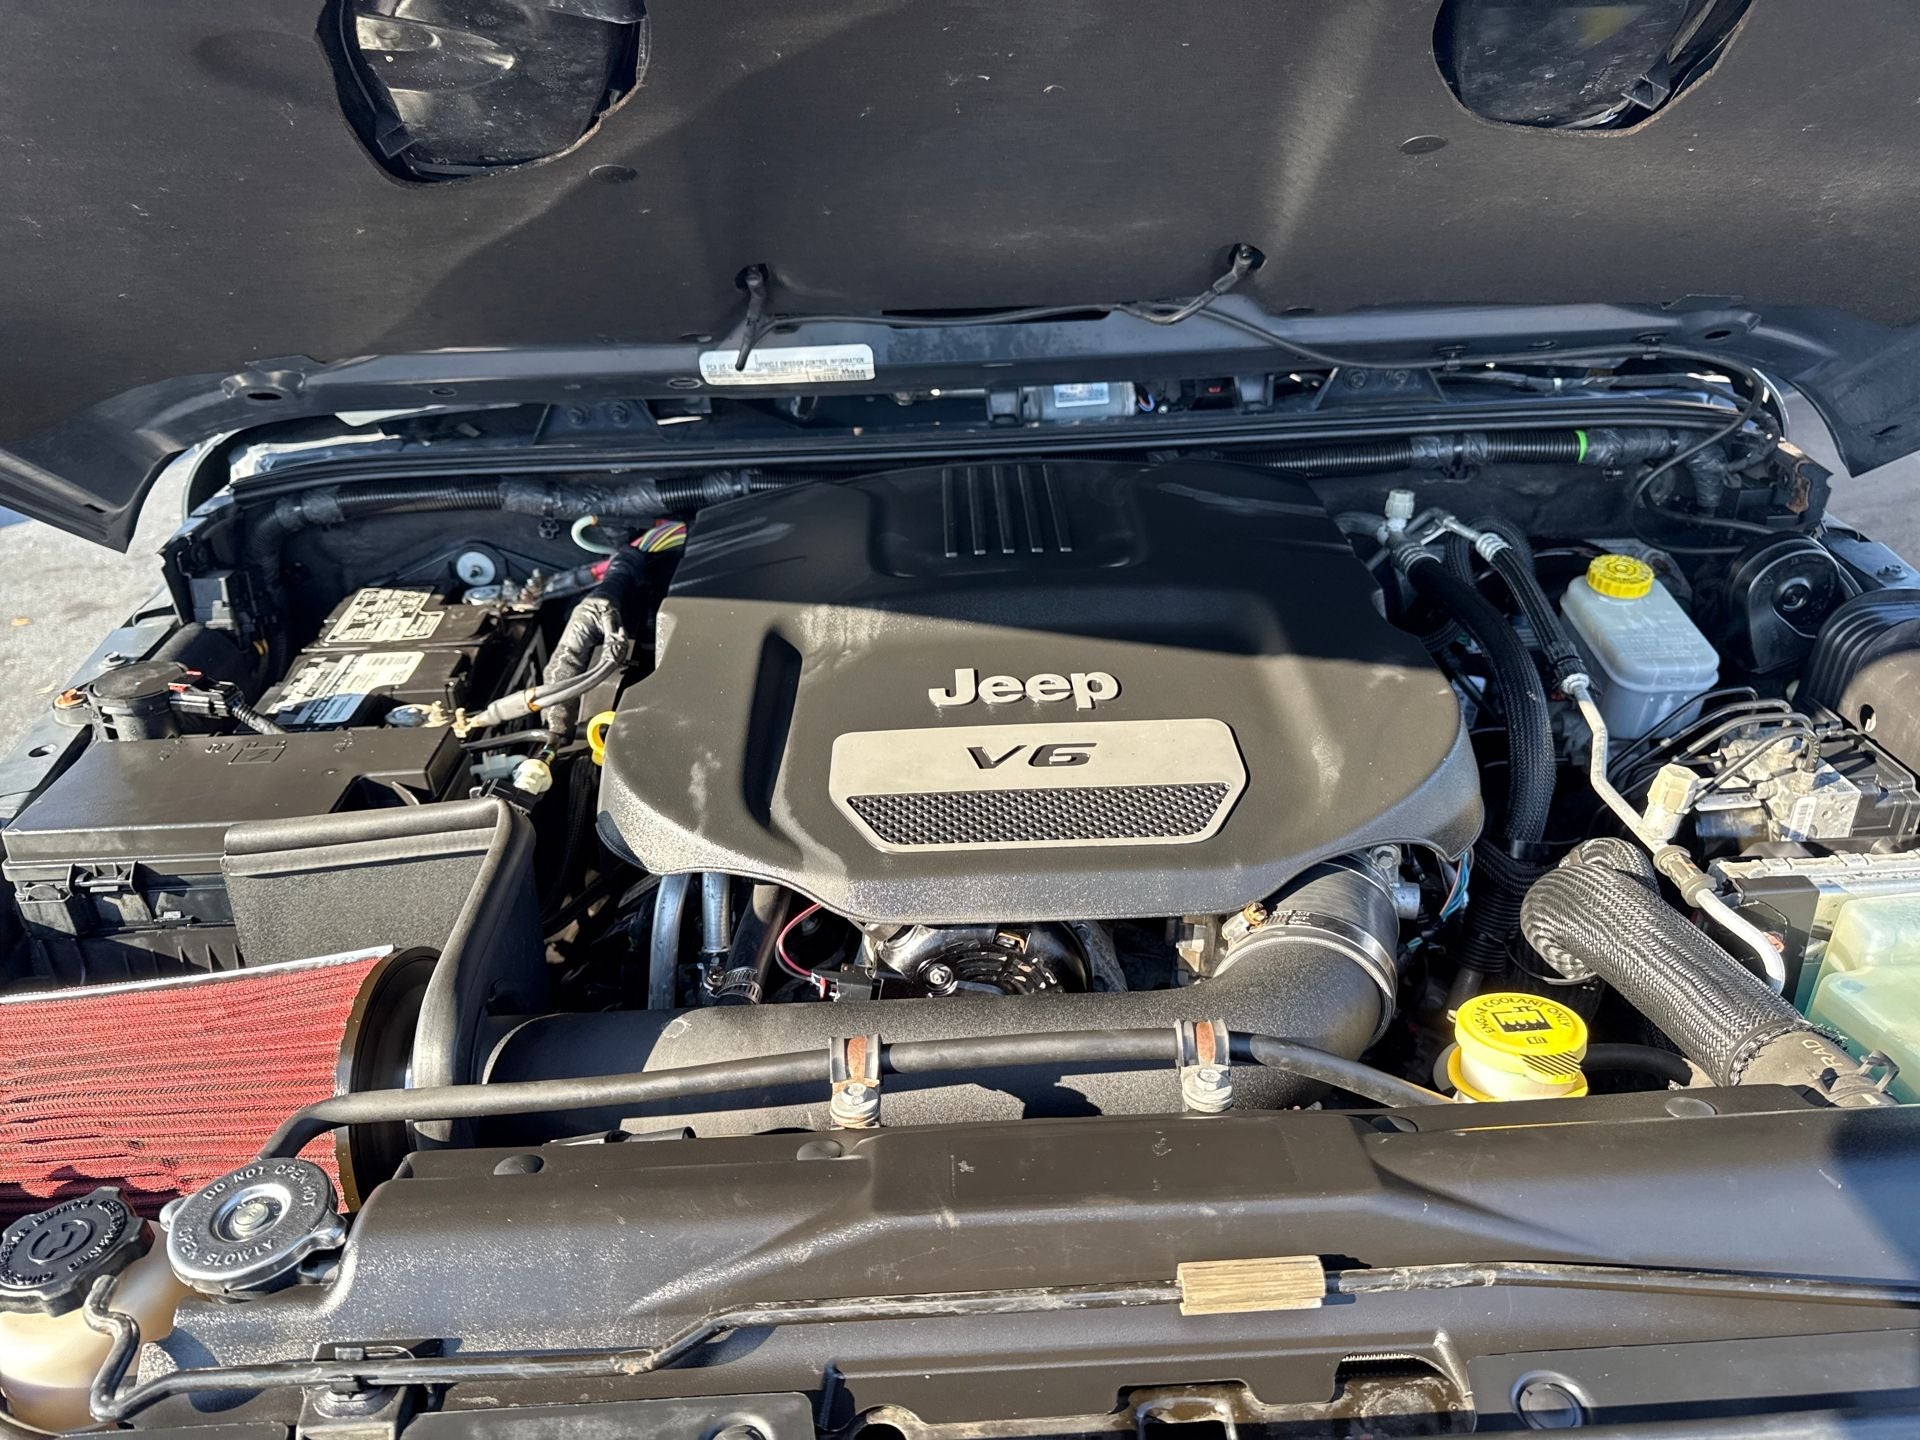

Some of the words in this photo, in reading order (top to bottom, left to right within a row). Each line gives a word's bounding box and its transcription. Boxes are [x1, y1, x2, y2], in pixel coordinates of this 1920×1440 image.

[779, 359, 804, 367] EMISSION
[805, 358, 828, 367] CONTROL
[830, 357, 864, 366] INFORMATION
[928, 668, 1119, 710] Jeep
[966, 743, 1097, 770] V6
[1482, 996, 1548, 1008] COOLANT
[1474, 1006, 1496, 1034] ENGINE
[1546, 1007, 1572, 1028] ONLY
[1801, 1039, 1844, 1069] RAD
[203, 1182, 226, 1201] DO
[234, 1166, 265, 1184] NOT
[274, 1164, 307, 1185] OPEN
[302, 1184, 316, 1207] HOT
[178, 1227, 200, 1260] OPEN
[203, 1239, 274, 1266] SLOWLY
